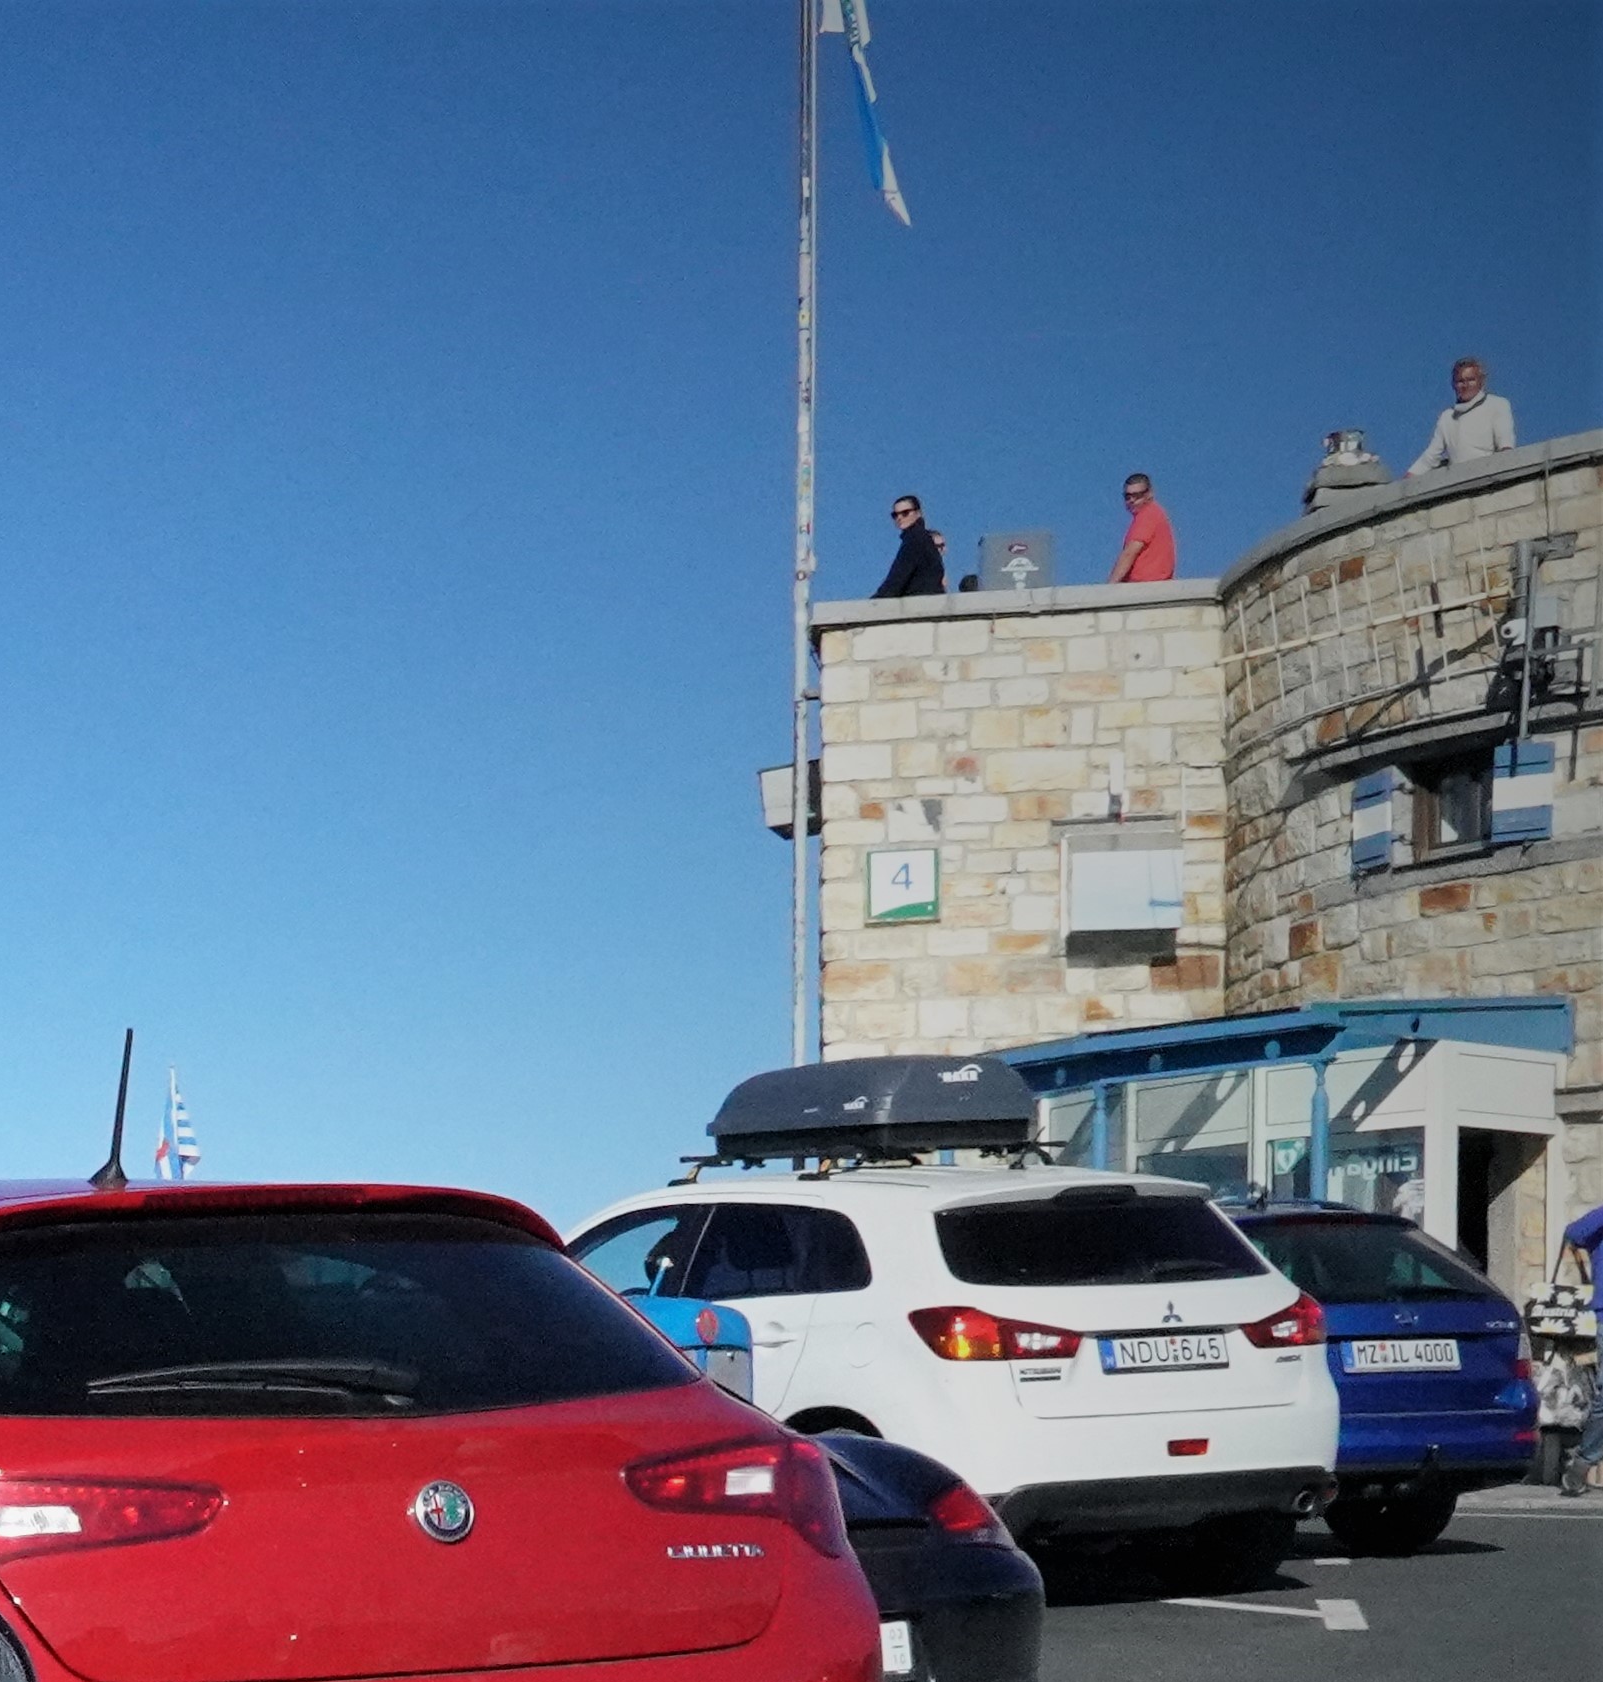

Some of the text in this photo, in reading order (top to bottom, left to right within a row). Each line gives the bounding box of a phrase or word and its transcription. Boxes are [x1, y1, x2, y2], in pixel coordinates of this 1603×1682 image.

[890, 862, 913, 890] 4
[1357, 1345, 1378, 1365] MZ
[1414, 1343, 1455, 1363] 4000
